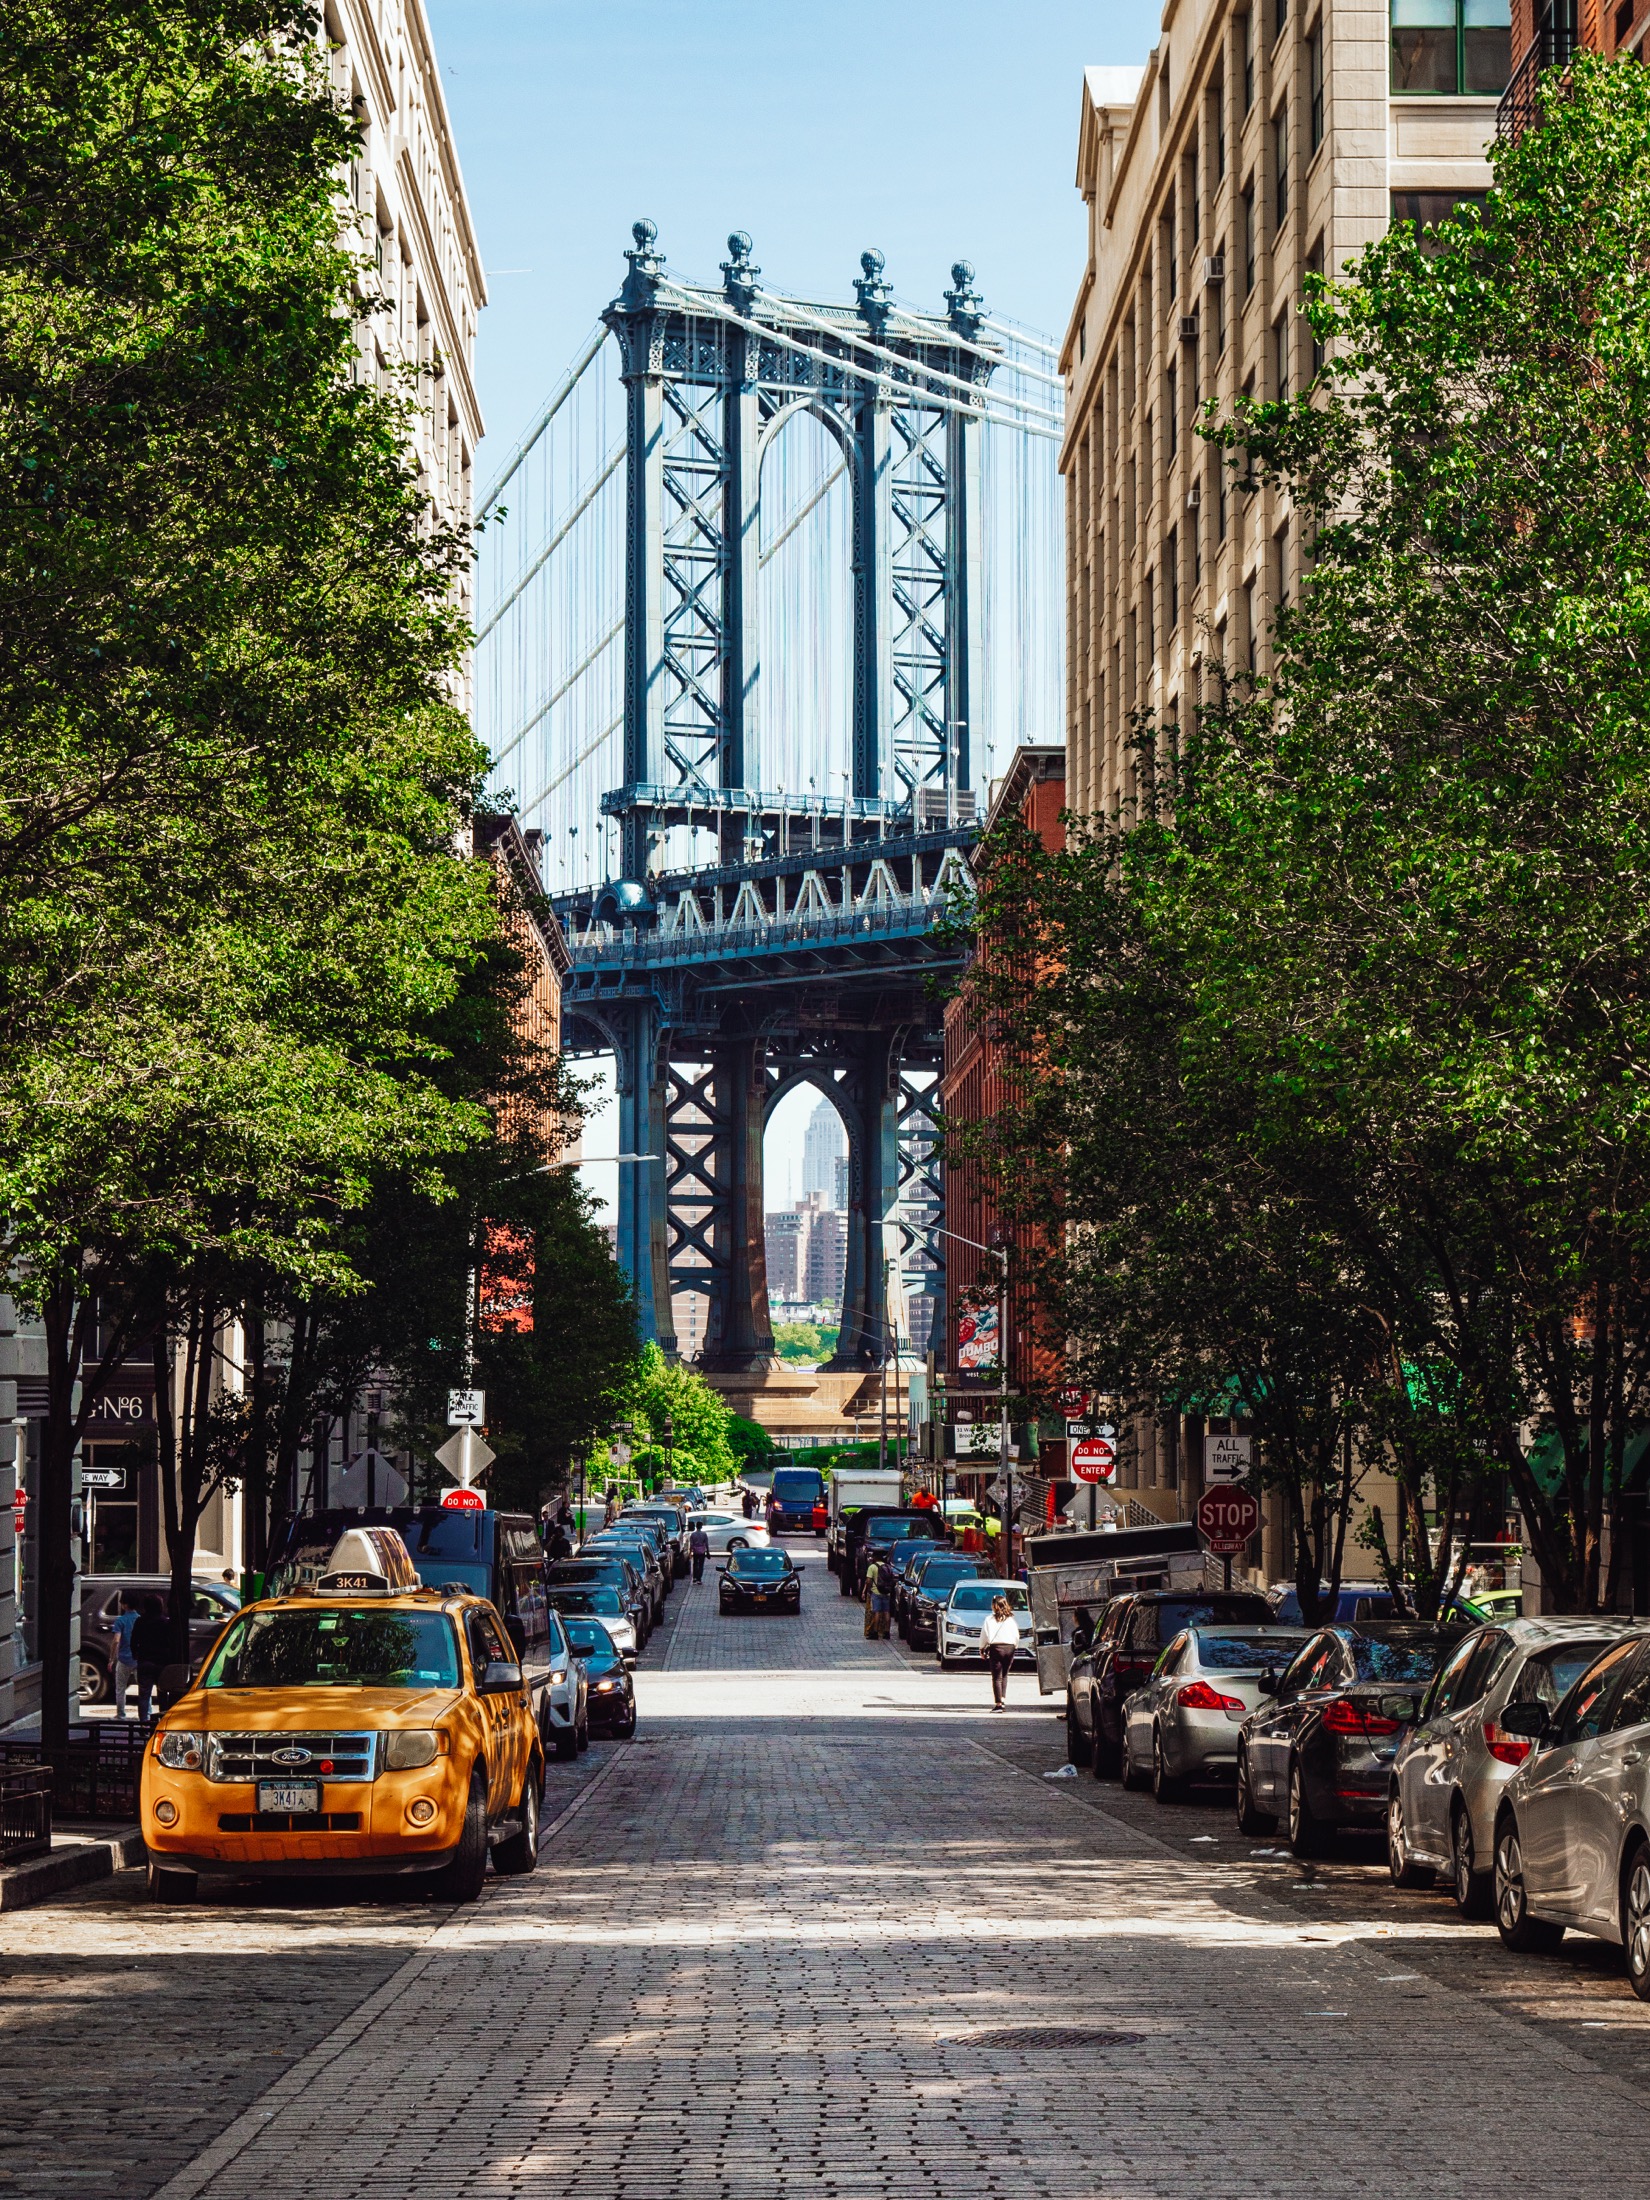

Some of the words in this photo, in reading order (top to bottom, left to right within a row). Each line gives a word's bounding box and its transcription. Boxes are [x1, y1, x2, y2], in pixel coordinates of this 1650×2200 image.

[959, 1337, 998, 1359] DUMBO
[1216, 1438, 1240, 1452] ALL
[1078, 1447, 1089, 1455] DO
[1080, 1466, 1106, 1475] ENTER
[92, 1474, 109, 1482] WAY
[447, 1498, 459, 1506] DO
[463, 1498, 479, 1507] NOT
[1202, 1503, 1254, 1526] STOP
[336, 1577, 368, 1588] 3K41
[281, 1752, 301, 1760] Ford
